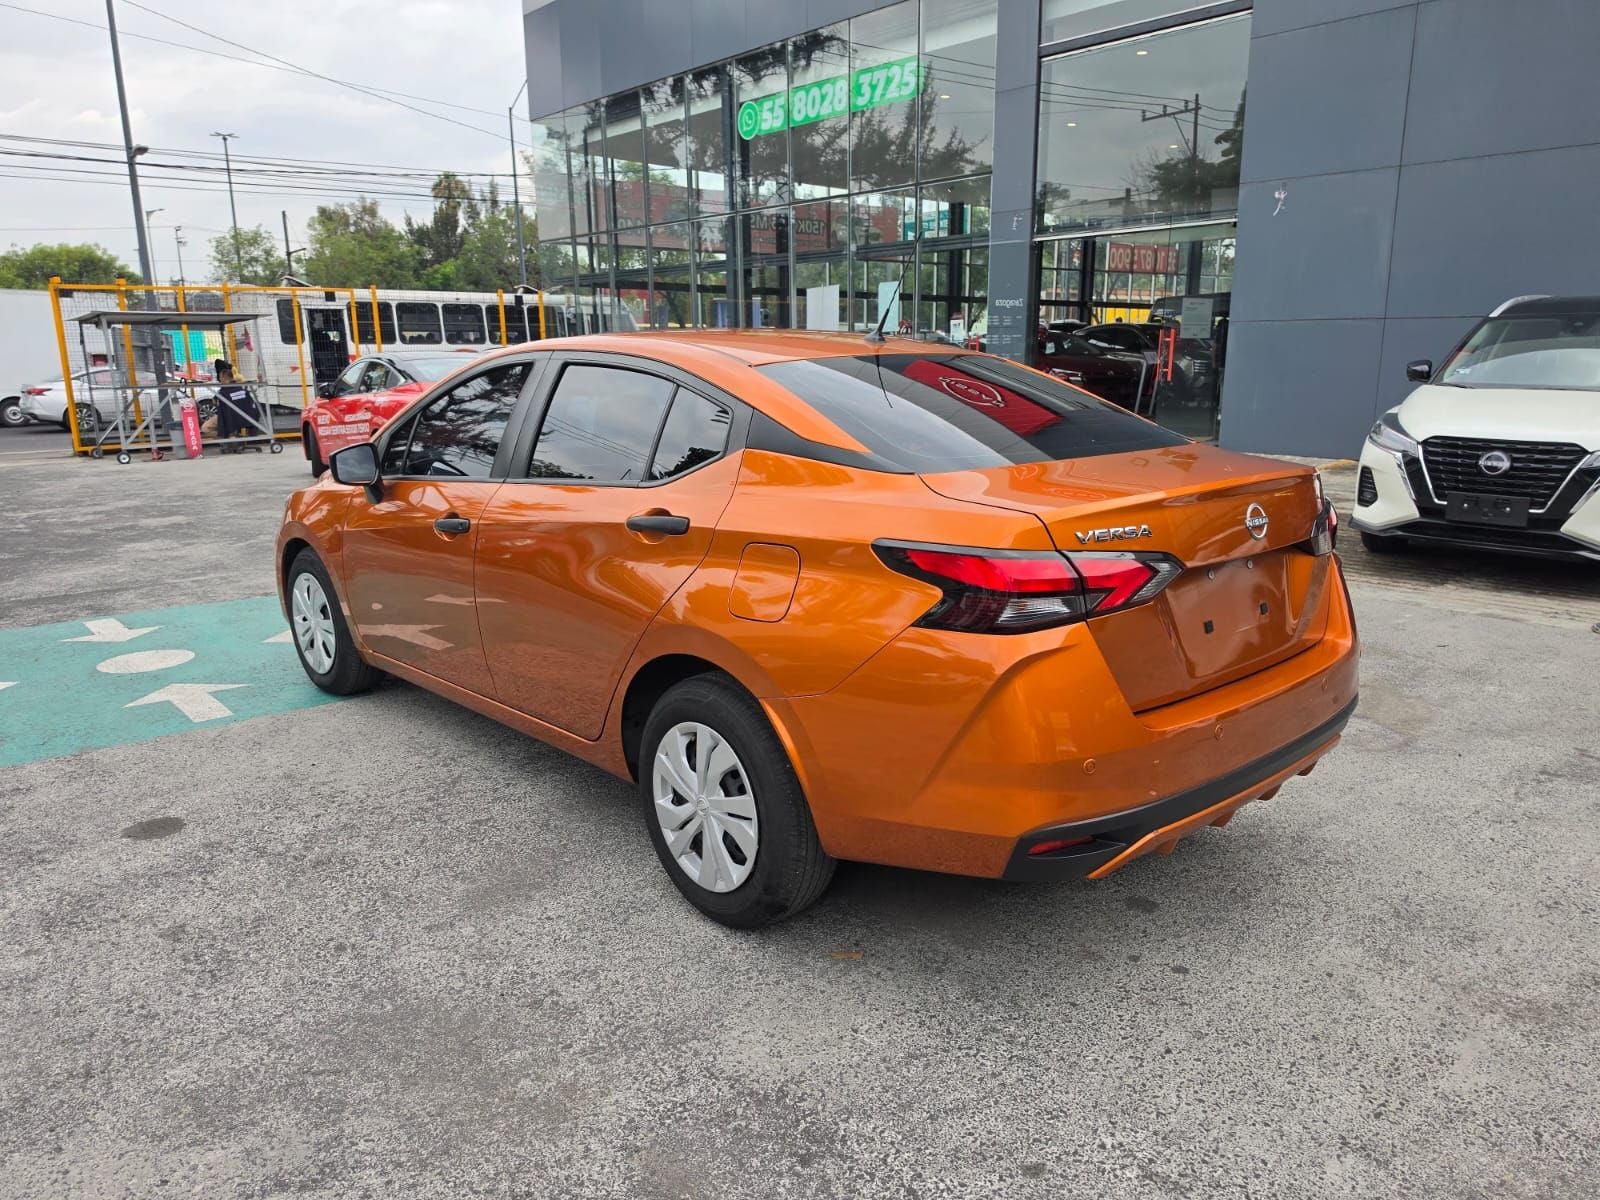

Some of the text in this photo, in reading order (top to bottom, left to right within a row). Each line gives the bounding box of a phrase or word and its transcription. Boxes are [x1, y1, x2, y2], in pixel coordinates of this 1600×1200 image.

[760, 61, 918, 131] 55 8028 3725
[1245, 515, 1270, 529] NISSAN
[1075, 525, 1153, 544] VERSA
